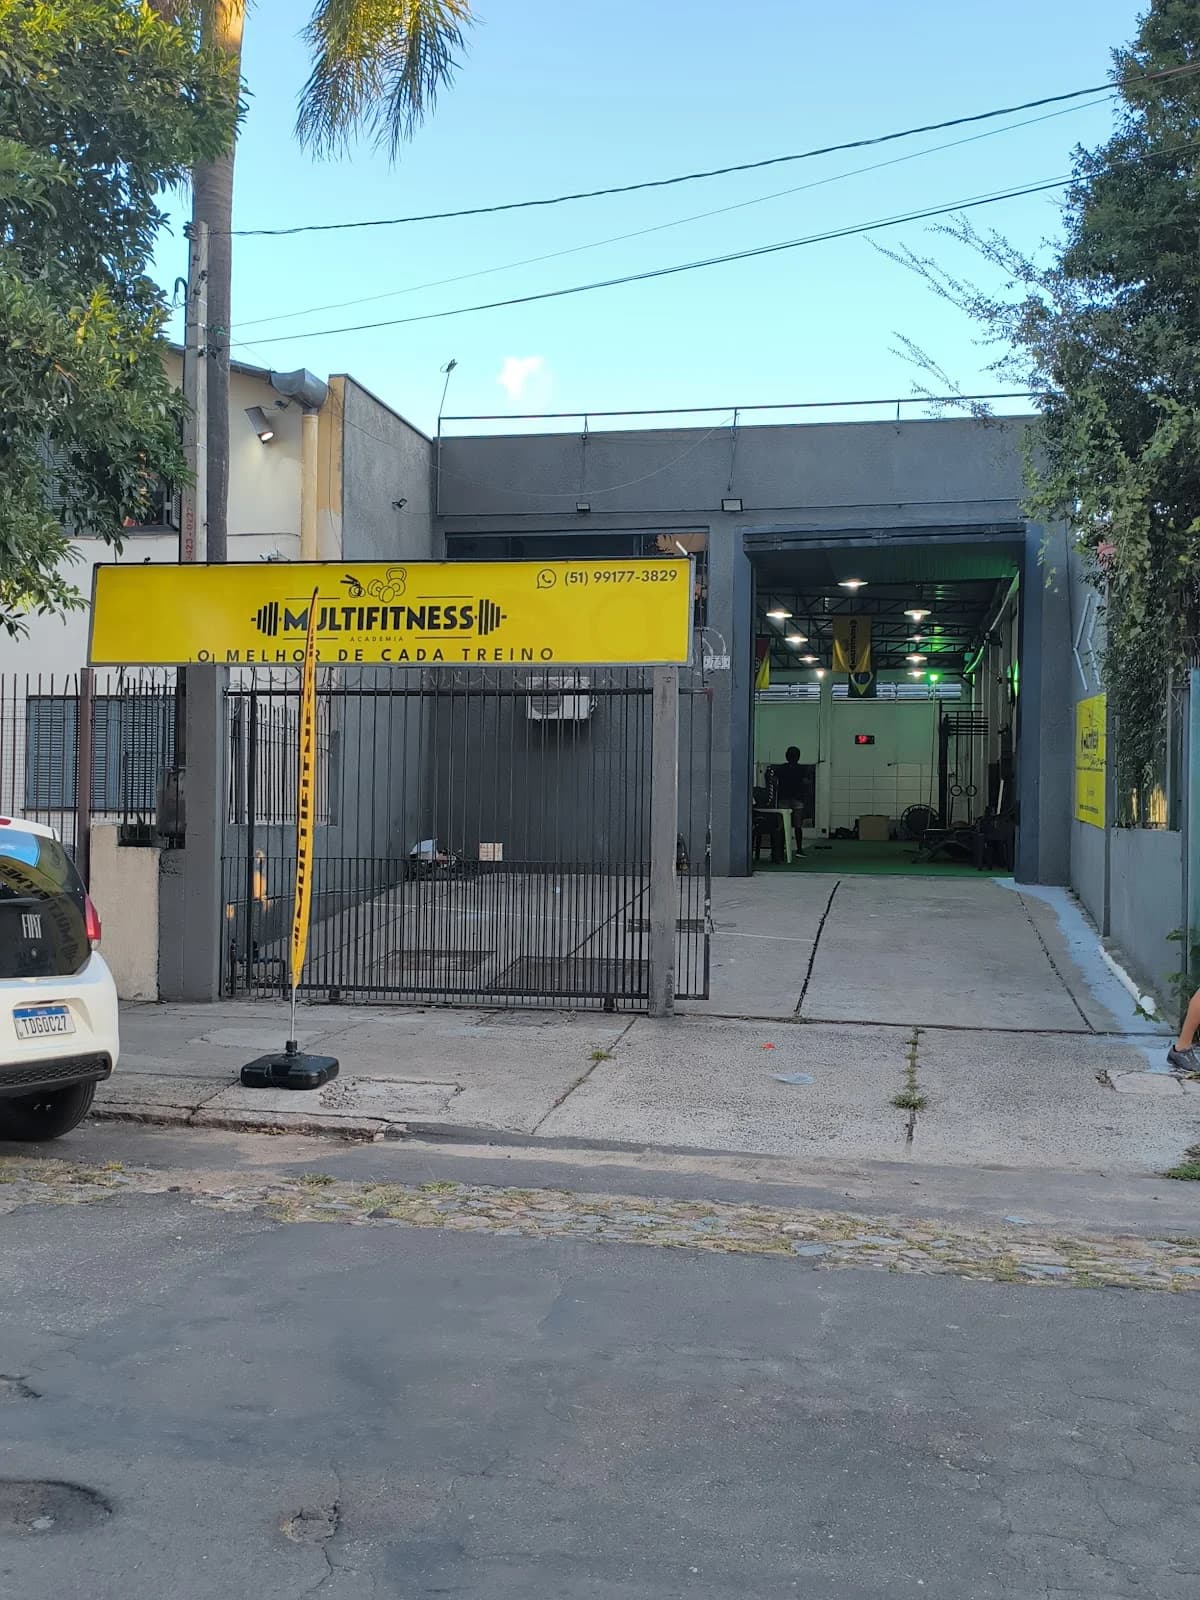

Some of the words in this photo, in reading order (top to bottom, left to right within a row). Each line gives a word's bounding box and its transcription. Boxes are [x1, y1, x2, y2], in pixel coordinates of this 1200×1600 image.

[564, 571, 588, 585] (51)
[593, 569, 677, 583] 99177-3829
[284, 606, 473, 632] MULTIFITNESS
[198, 650, 210, 662] O
[338, 649, 363, 661] DE
[381, 648, 445, 661] CADA
[462, 647, 553, 661] TREINO
[21, 914, 42, 939] FIAT
